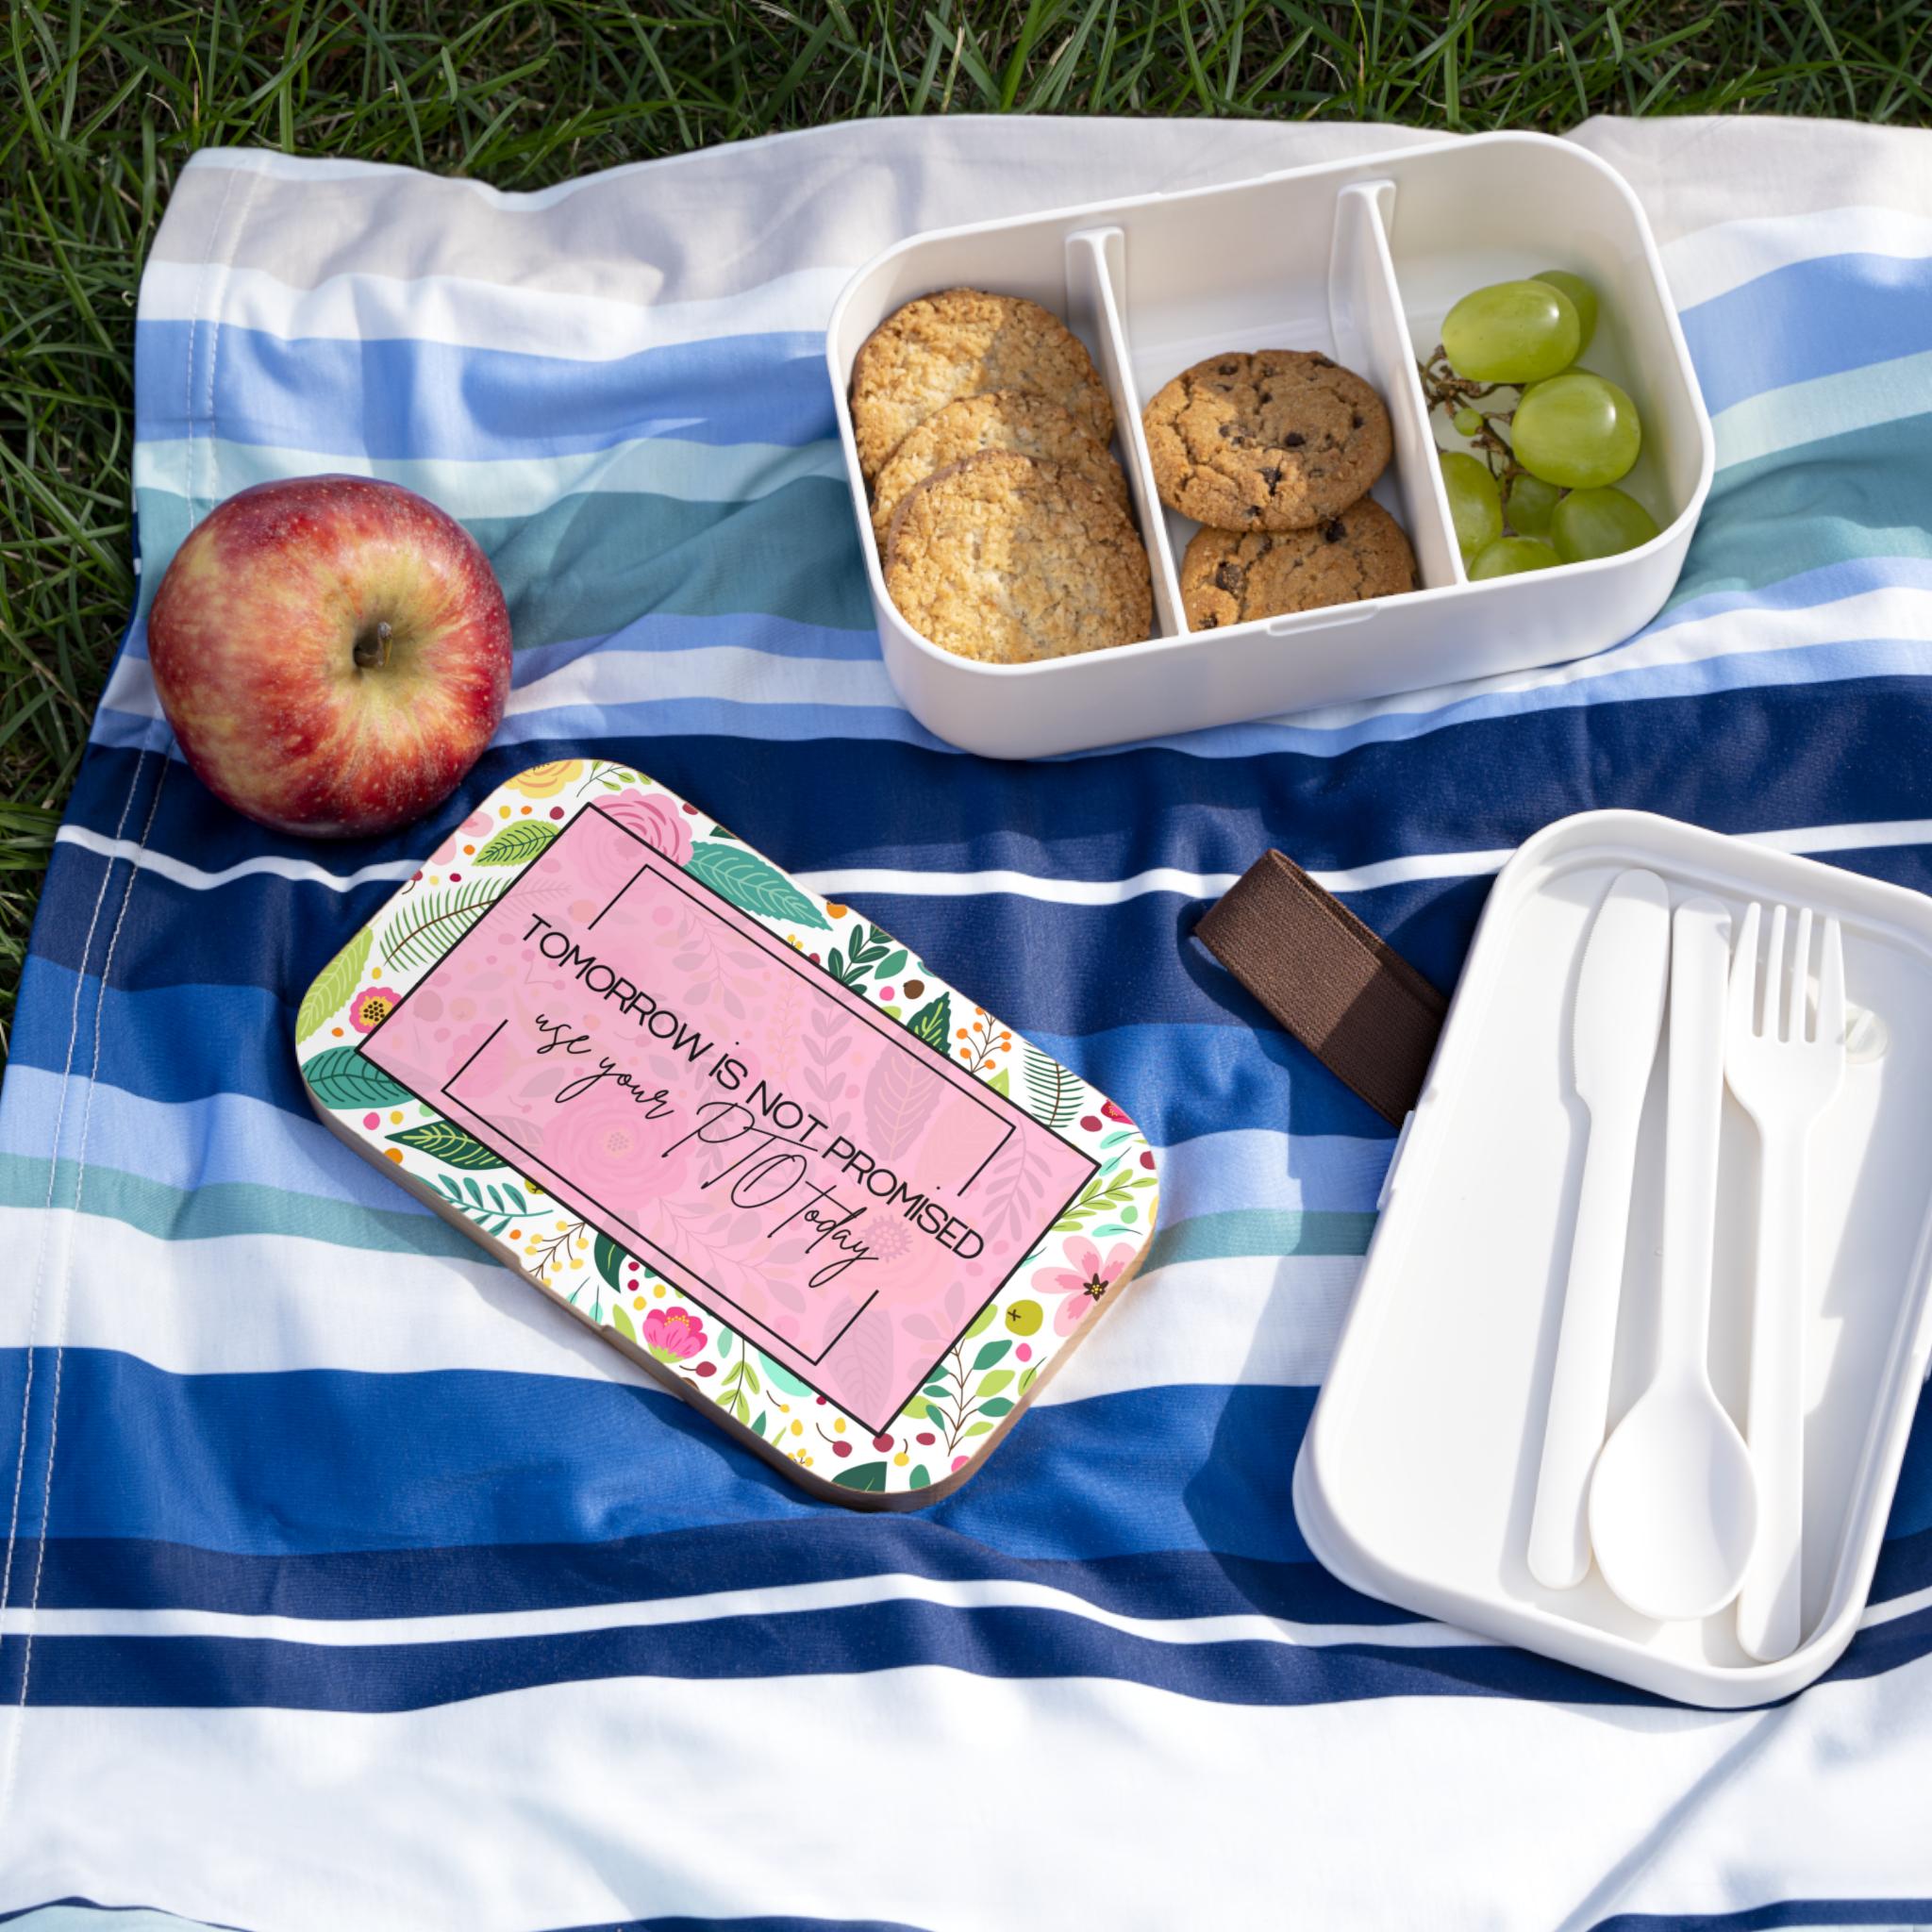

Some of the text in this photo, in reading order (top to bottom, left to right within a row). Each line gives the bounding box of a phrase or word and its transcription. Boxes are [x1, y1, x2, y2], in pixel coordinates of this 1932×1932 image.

[522, 912, 715, 1063] TOMORROW
[745, 1079, 829, 1143] NOT
[535, 1013, 592, 1055] use
[554, 1056, 675, 1120] your
[660, 1101, 819, 1210] PTO
